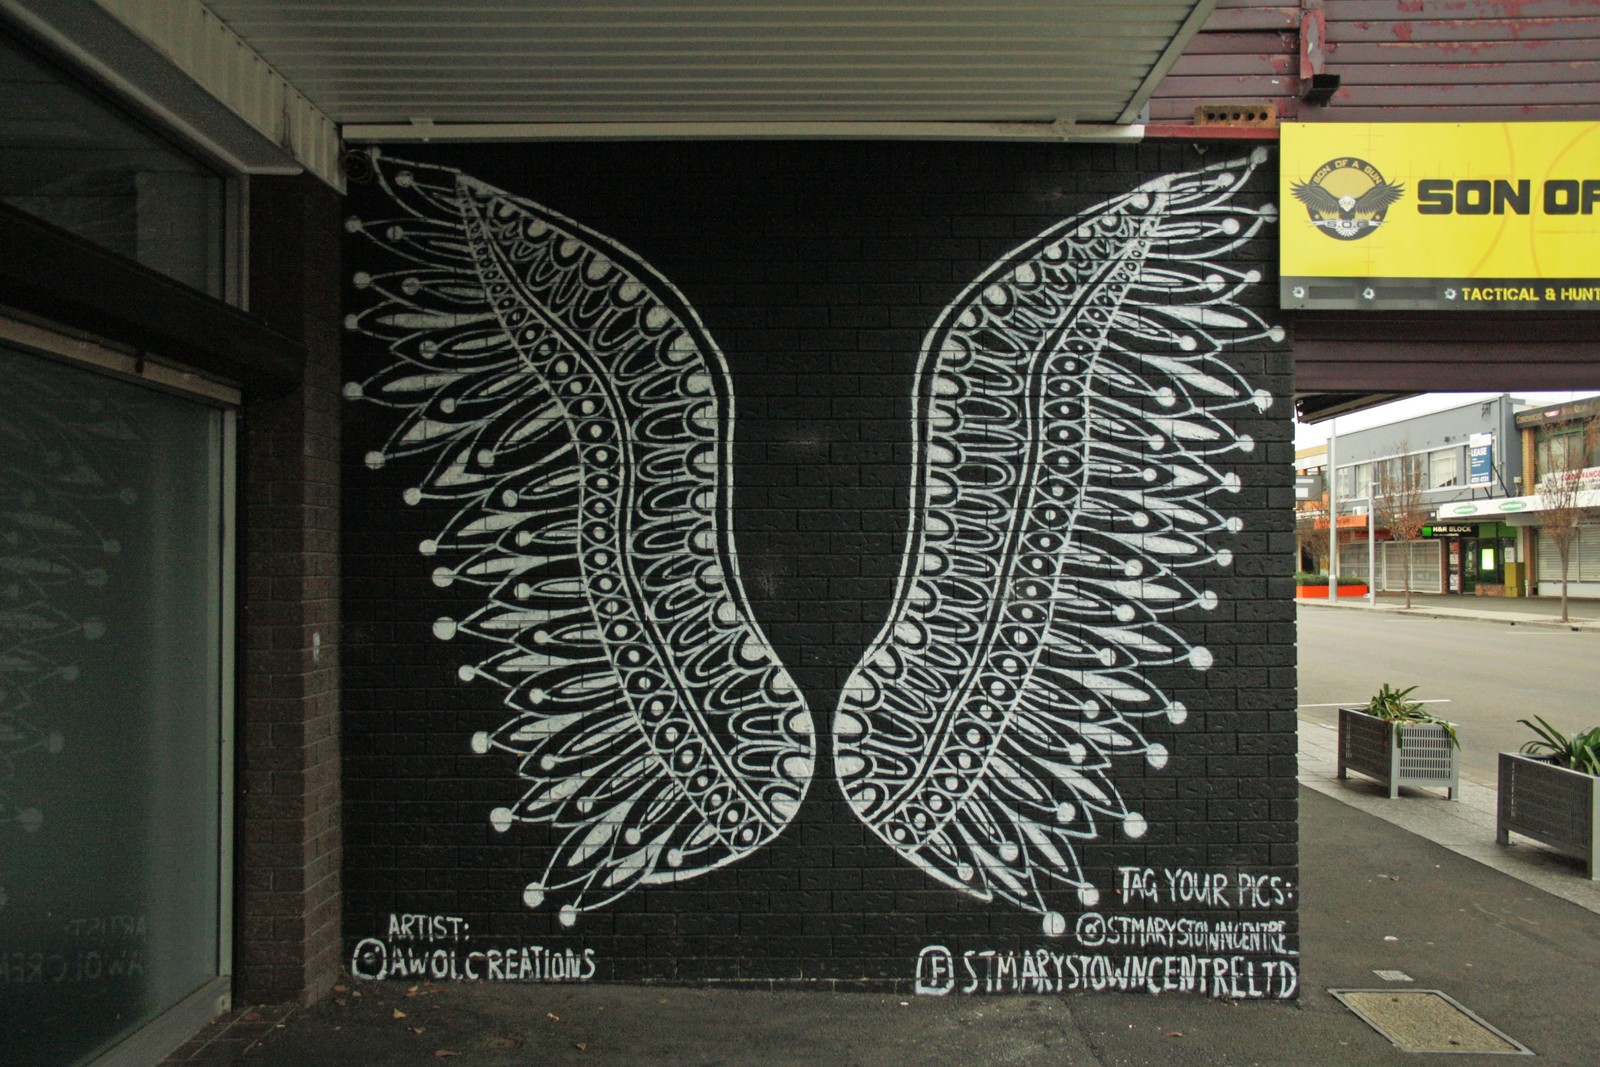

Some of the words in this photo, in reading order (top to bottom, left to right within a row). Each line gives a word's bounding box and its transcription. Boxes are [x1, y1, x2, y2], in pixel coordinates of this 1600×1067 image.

[1313, 165, 1332, 184] SON
[1334, 159, 1349, 168] OF
[1352, 160, 1360, 168] A
[1363, 166, 1382, 185] GUN
[1417, 179, 1531, 215] SON
[1543, 179, 1600, 215] OF
[1461, 287, 1539, 302] TACTICAL
[1545, 288, 1557, 301] &
[1470, 447, 1487, 457] LEASE
[1118, 866, 1158, 904] TAG
[1165, 867, 1230, 907] YOUR
[1237, 872, 1294, 908] PICS:
[388, 913, 470, 943] ARTIST:
